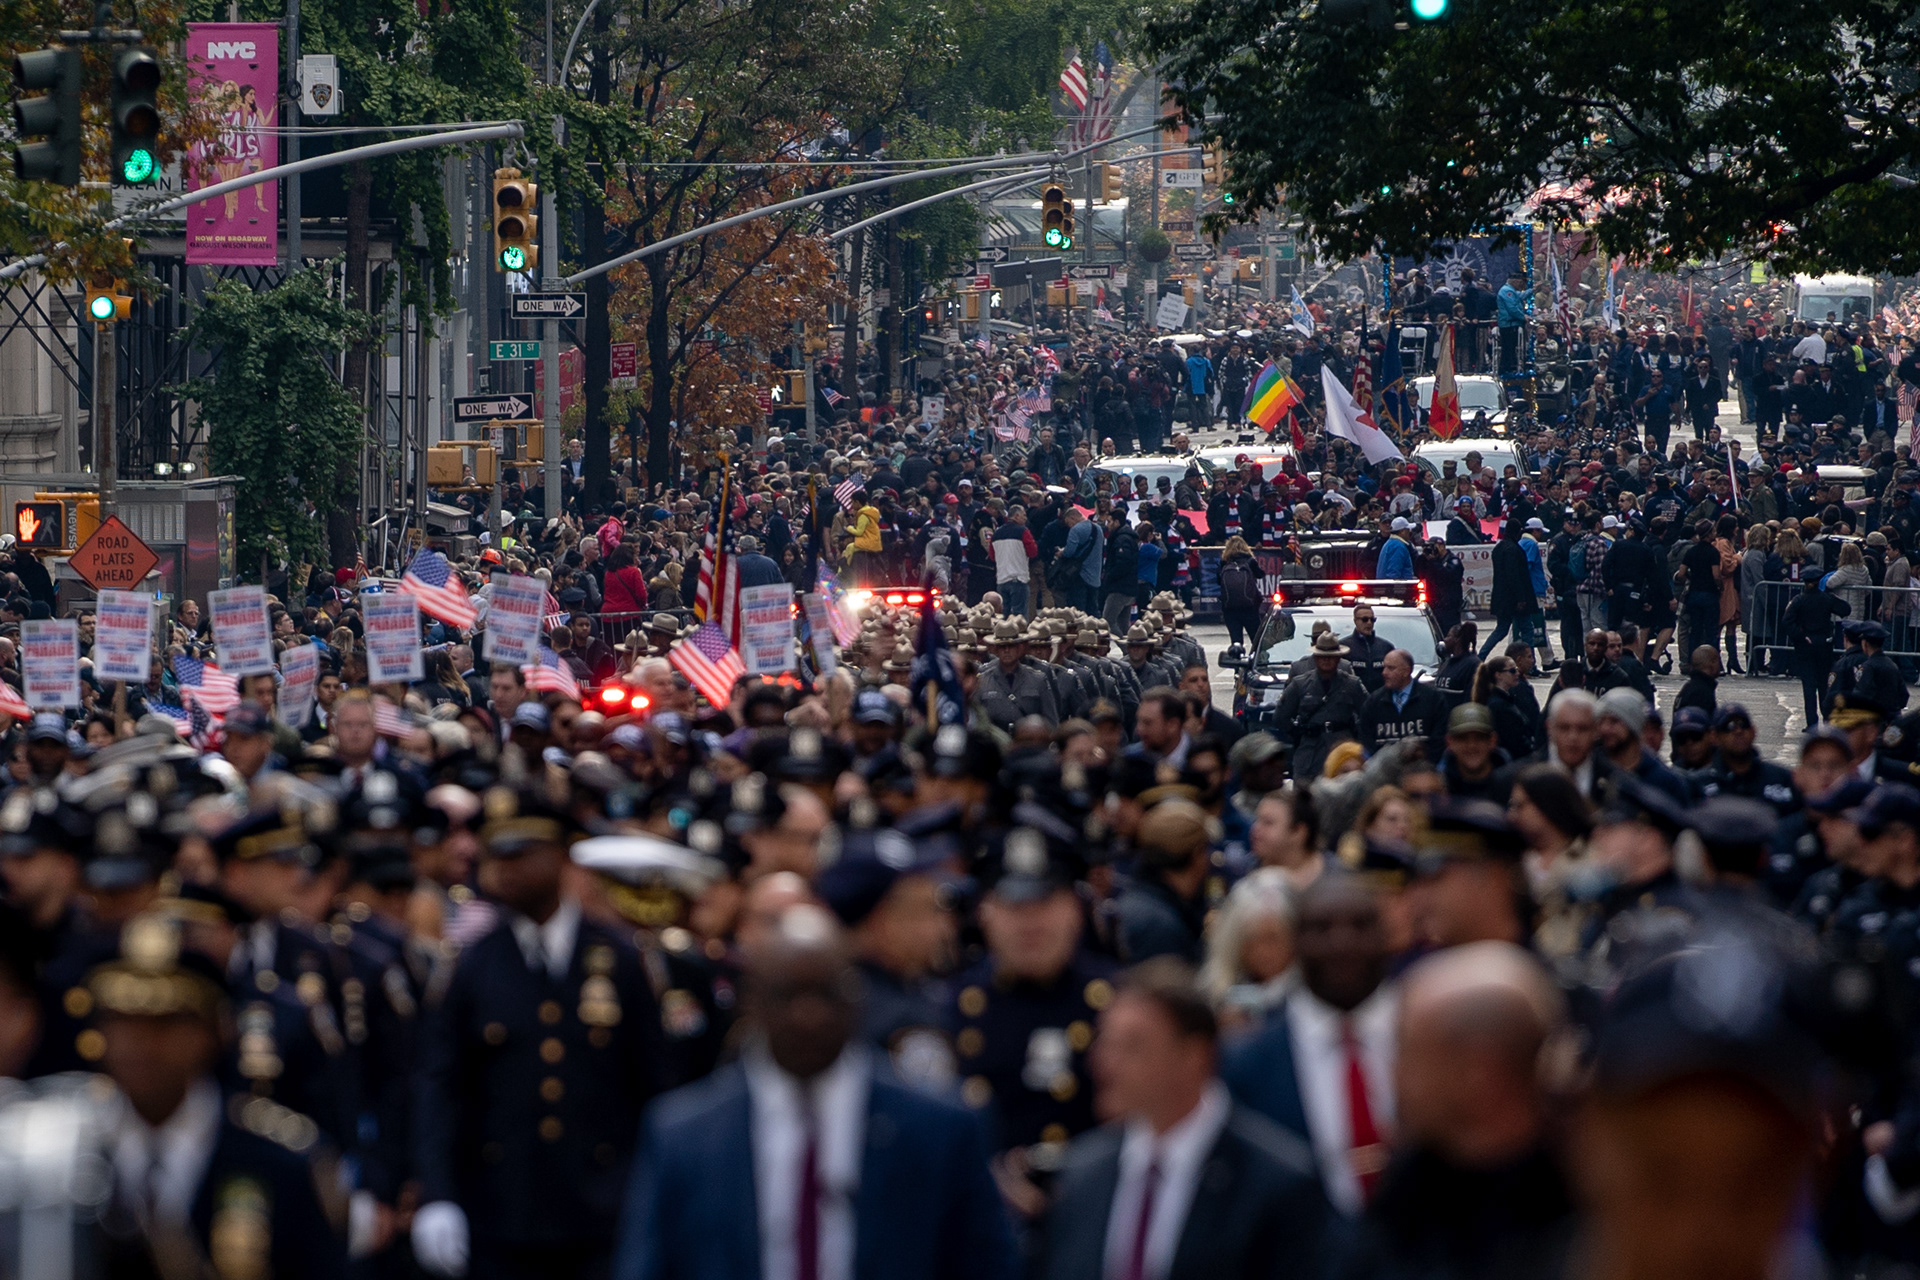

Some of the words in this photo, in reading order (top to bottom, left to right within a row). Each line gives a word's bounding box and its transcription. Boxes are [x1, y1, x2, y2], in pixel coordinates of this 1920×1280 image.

[208, 41, 256, 59] NYC
[522, 301, 544, 311] ONE
[553, 301, 575, 311] WAY
[496, 344, 504, 358] E
[509, 343, 522, 358] 31
[527, 343, 535, 351] ST
[465, 403, 488, 415] ONE
[497, 402, 521, 413] WAY
[97, 536, 129, 549] ROAD
[93, 552, 135, 566] PLATES
[95, 569, 134, 581] AHEAD
[1377, 719, 1424, 736] POLICE
